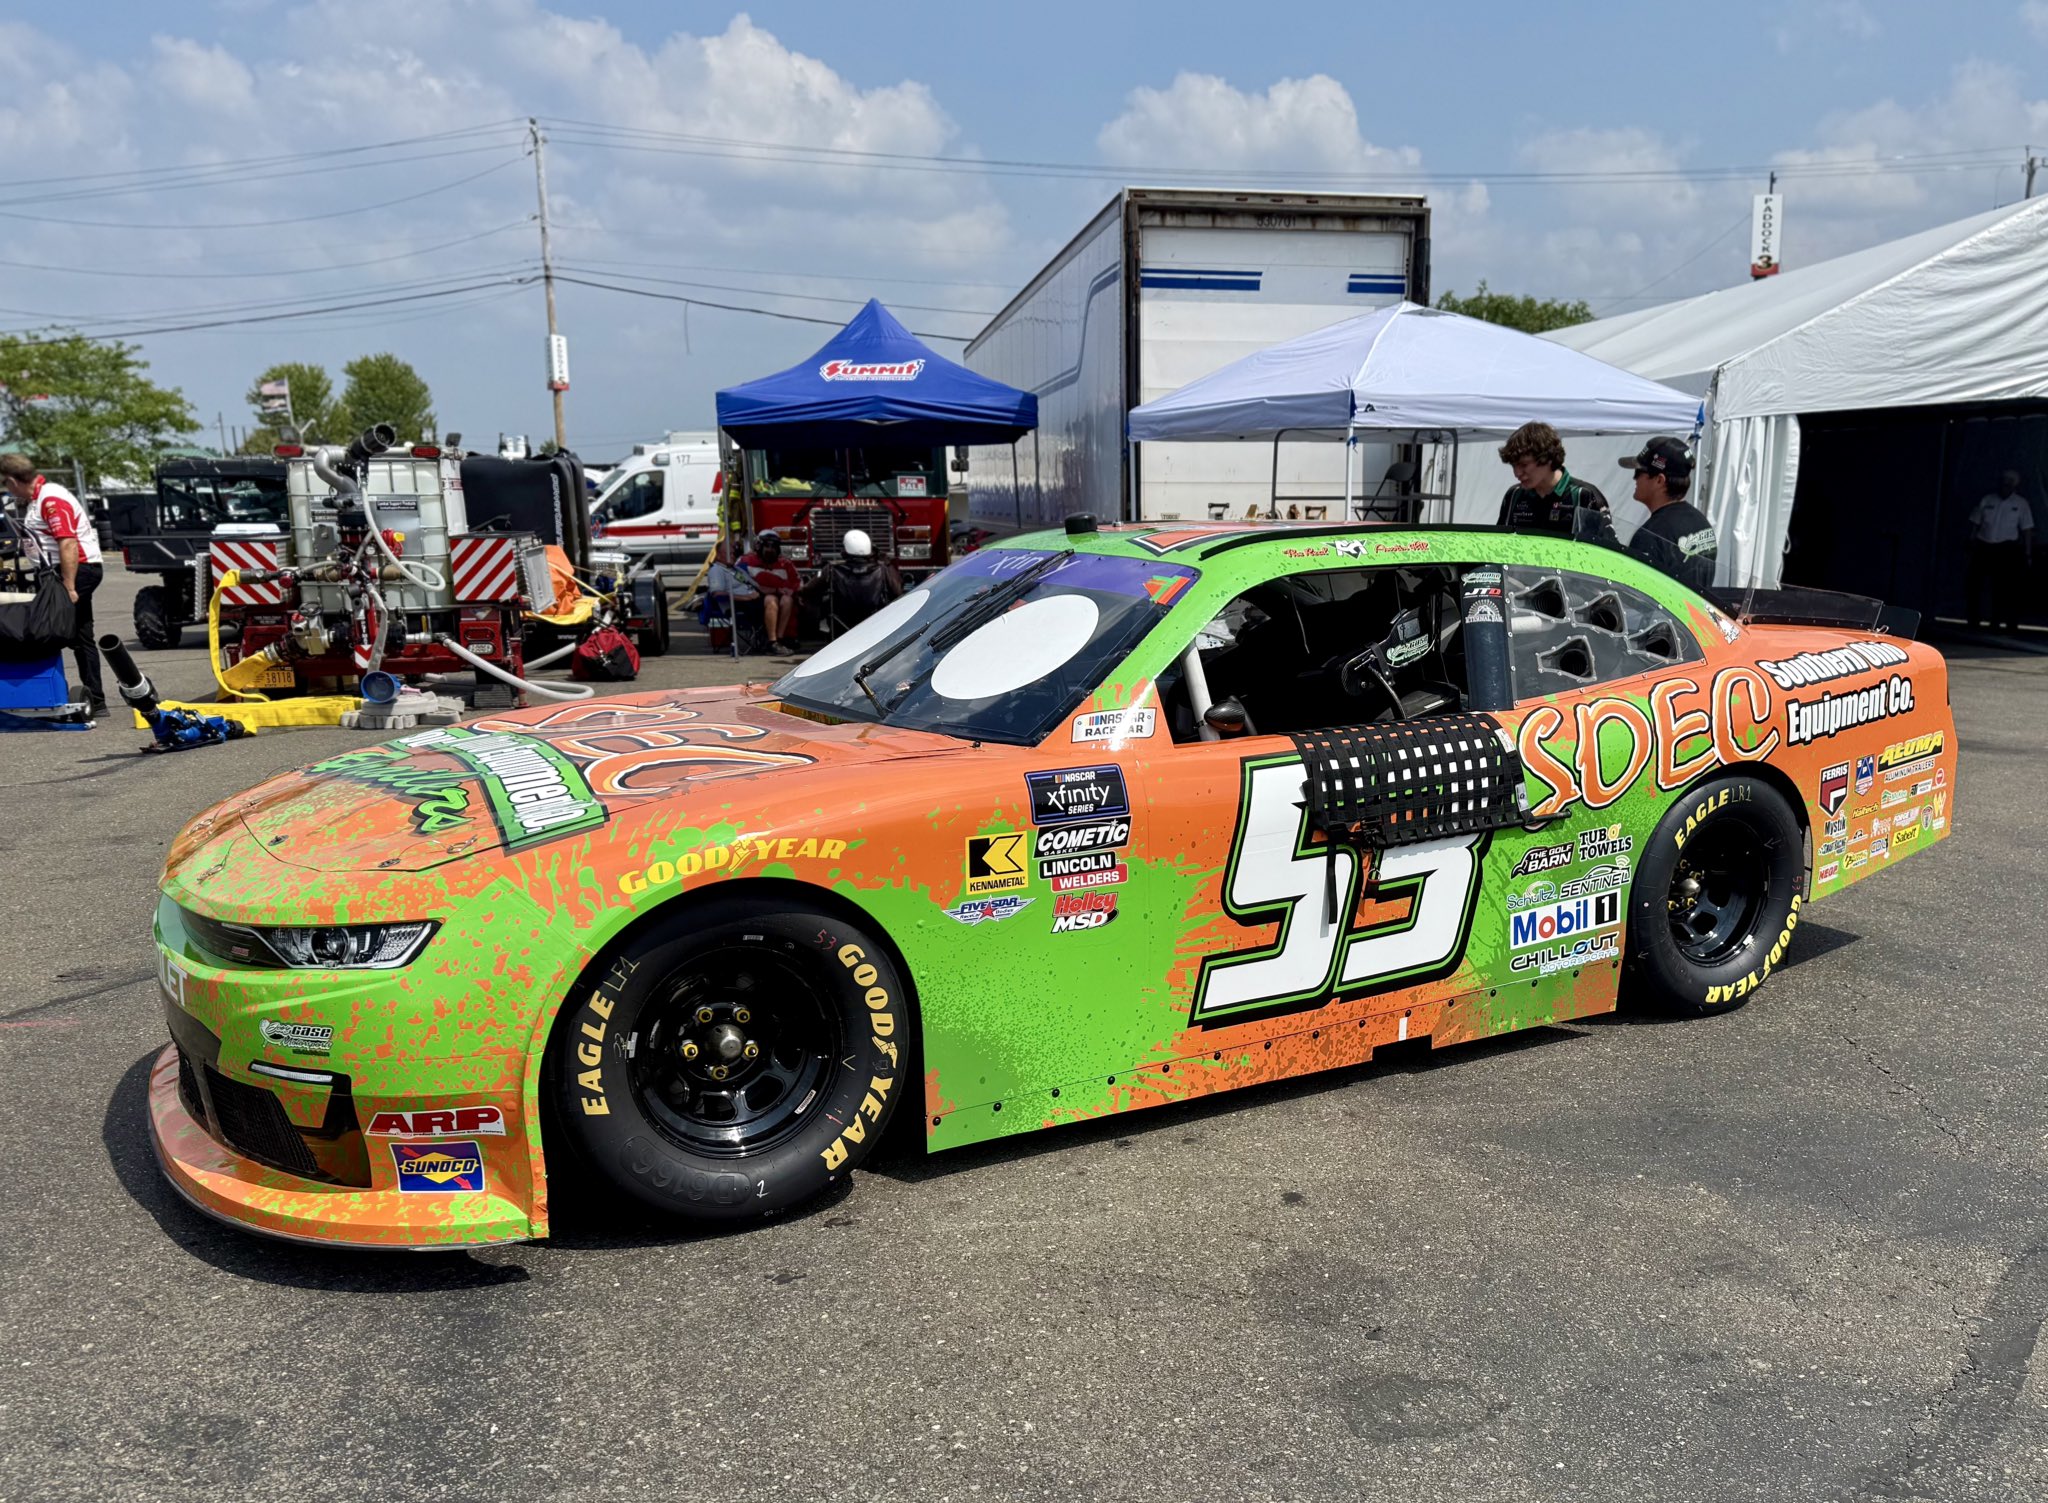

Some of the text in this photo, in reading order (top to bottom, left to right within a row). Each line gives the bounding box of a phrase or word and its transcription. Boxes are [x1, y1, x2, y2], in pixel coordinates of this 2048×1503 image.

[1757, 196, 1773, 270] PADDOCK 3
[676, 454, 691, 465] 177
[900, 483, 925, 491] SALE
[823, 498, 879, 507] PLAINVILLE
[1464, 587, 1502, 596] JTD
[1758, 641, 1908, 688] Southern Ohio
[1786, 676, 1914, 743] Equipment Co.
[1880, 731, 1944, 767] ALUMA
[1065, 771, 1096, 783] NASCAR
[1821, 764, 1848, 782] FERRIS
[1046, 783, 1110, 811] xfinity
[1068, 803, 1094, 815] SERIES
[1674, 787, 1730, 850] EAGLE
[1038, 822, 1129, 852] COMETIC
[1579, 828, 1607, 846] TUB
[1824, 818, 1847, 836] Mystik
[1044, 847, 1079, 856] GASKET
[1529, 844, 1574, 860] THE GOLF
[1579, 836, 1633, 861] TOWELS
[1043, 854, 1112, 877] LINCOLN
[1527, 852, 1572, 872] BARN
[969, 876, 1025, 892] KENNAMETAL
[1059, 871, 1120, 889] WELDERS
[1560, 871, 1630, 898] SENTINEL
[960, 897, 1018, 914] FIVE STAR
[1053, 891, 1118, 917] Holley
[1051, 911, 1109, 933] MSD
[1513, 899, 1588, 946] Mobil
[1510, 932, 1619, 971] CHILLOUT
[1539, 948, 1619, 975] MOTORSPORTS
[577, 990, 615, 1117] EAGLE
[369, 1107, 501, 1134] ARP
[403, 1159, 476, 1173] SUNOCO
